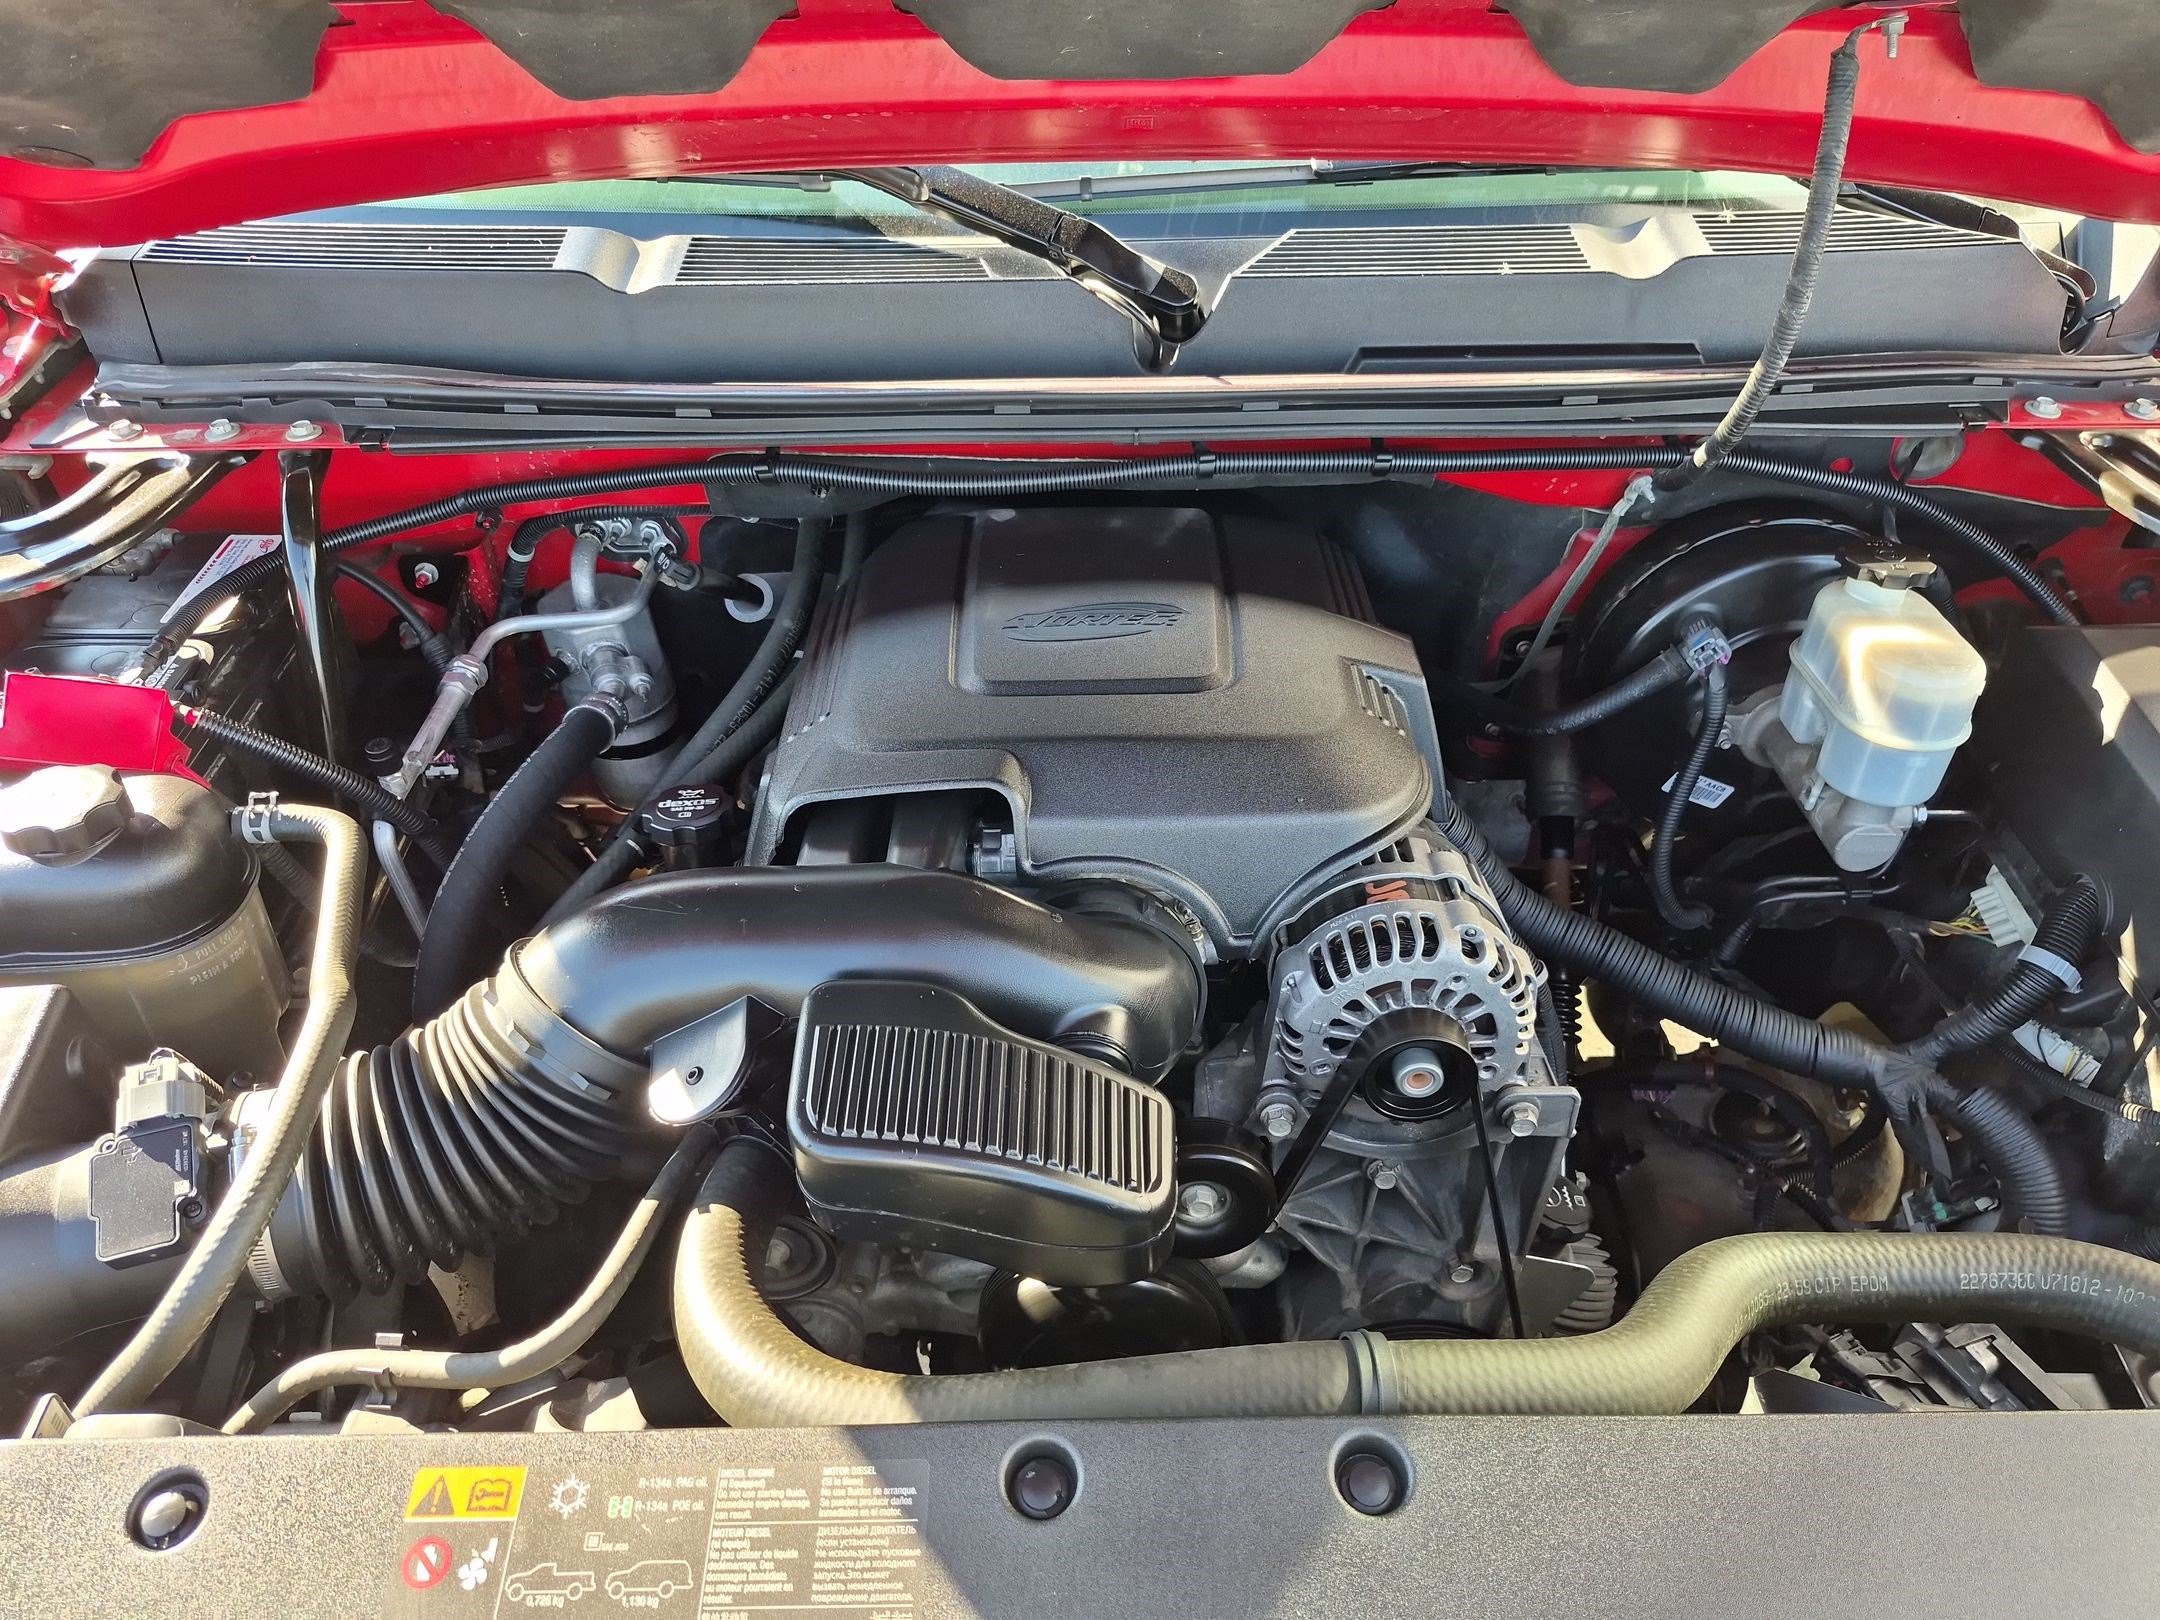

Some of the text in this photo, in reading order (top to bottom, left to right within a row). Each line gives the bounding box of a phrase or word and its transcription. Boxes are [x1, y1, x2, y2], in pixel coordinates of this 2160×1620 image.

[658, 799, 718, 808] dexos
[1851, 1275, 1889, 1292] EPDM
[823, 1466, 876, 1475] MOTOR DIESEL
[873, 1487, 882, 1495] de
[883, 1486, 917, 1497] arranque.
[819, 1497, 830, 1506] Se
[859, 1497, 889, 1507] producir
[890, 1496, 912, 1505] daños
[817, 1525, 916, 1537] ДИЗЕЛЬНЫЙ ДВИГАТЕЛЬ
[552, 1596, 564, 1609] kg
[647, 1595, 659, 1609] kg
